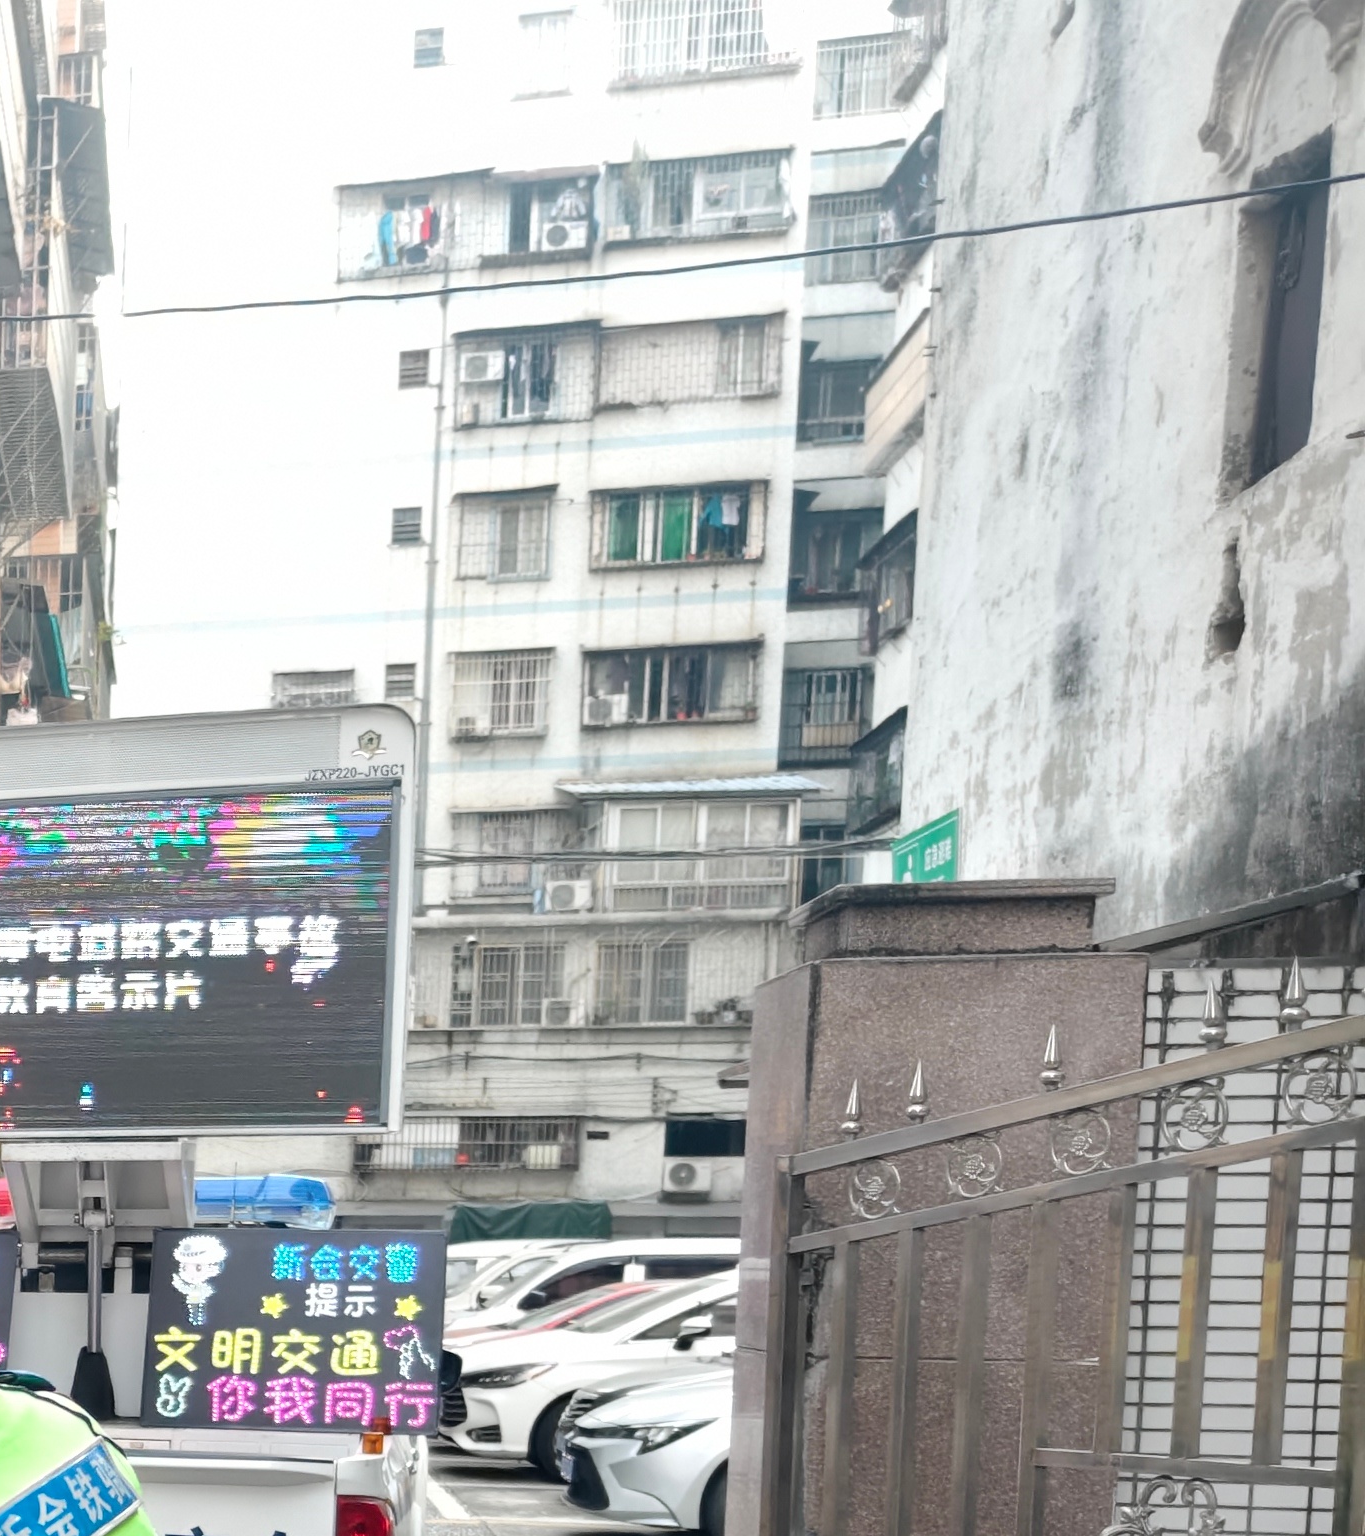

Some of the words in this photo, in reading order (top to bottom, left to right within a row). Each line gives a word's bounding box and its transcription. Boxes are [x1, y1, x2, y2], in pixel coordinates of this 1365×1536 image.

[305, 764, 405, 781] JZXP220-JYGC1
[272, 1241, 420, 1283] 新会交警
[304, 1283, 377, 1318] 提示
[154, 1326, 382, 1376] 文明交通
[207, 1374, 437, 1427] 你我同行
